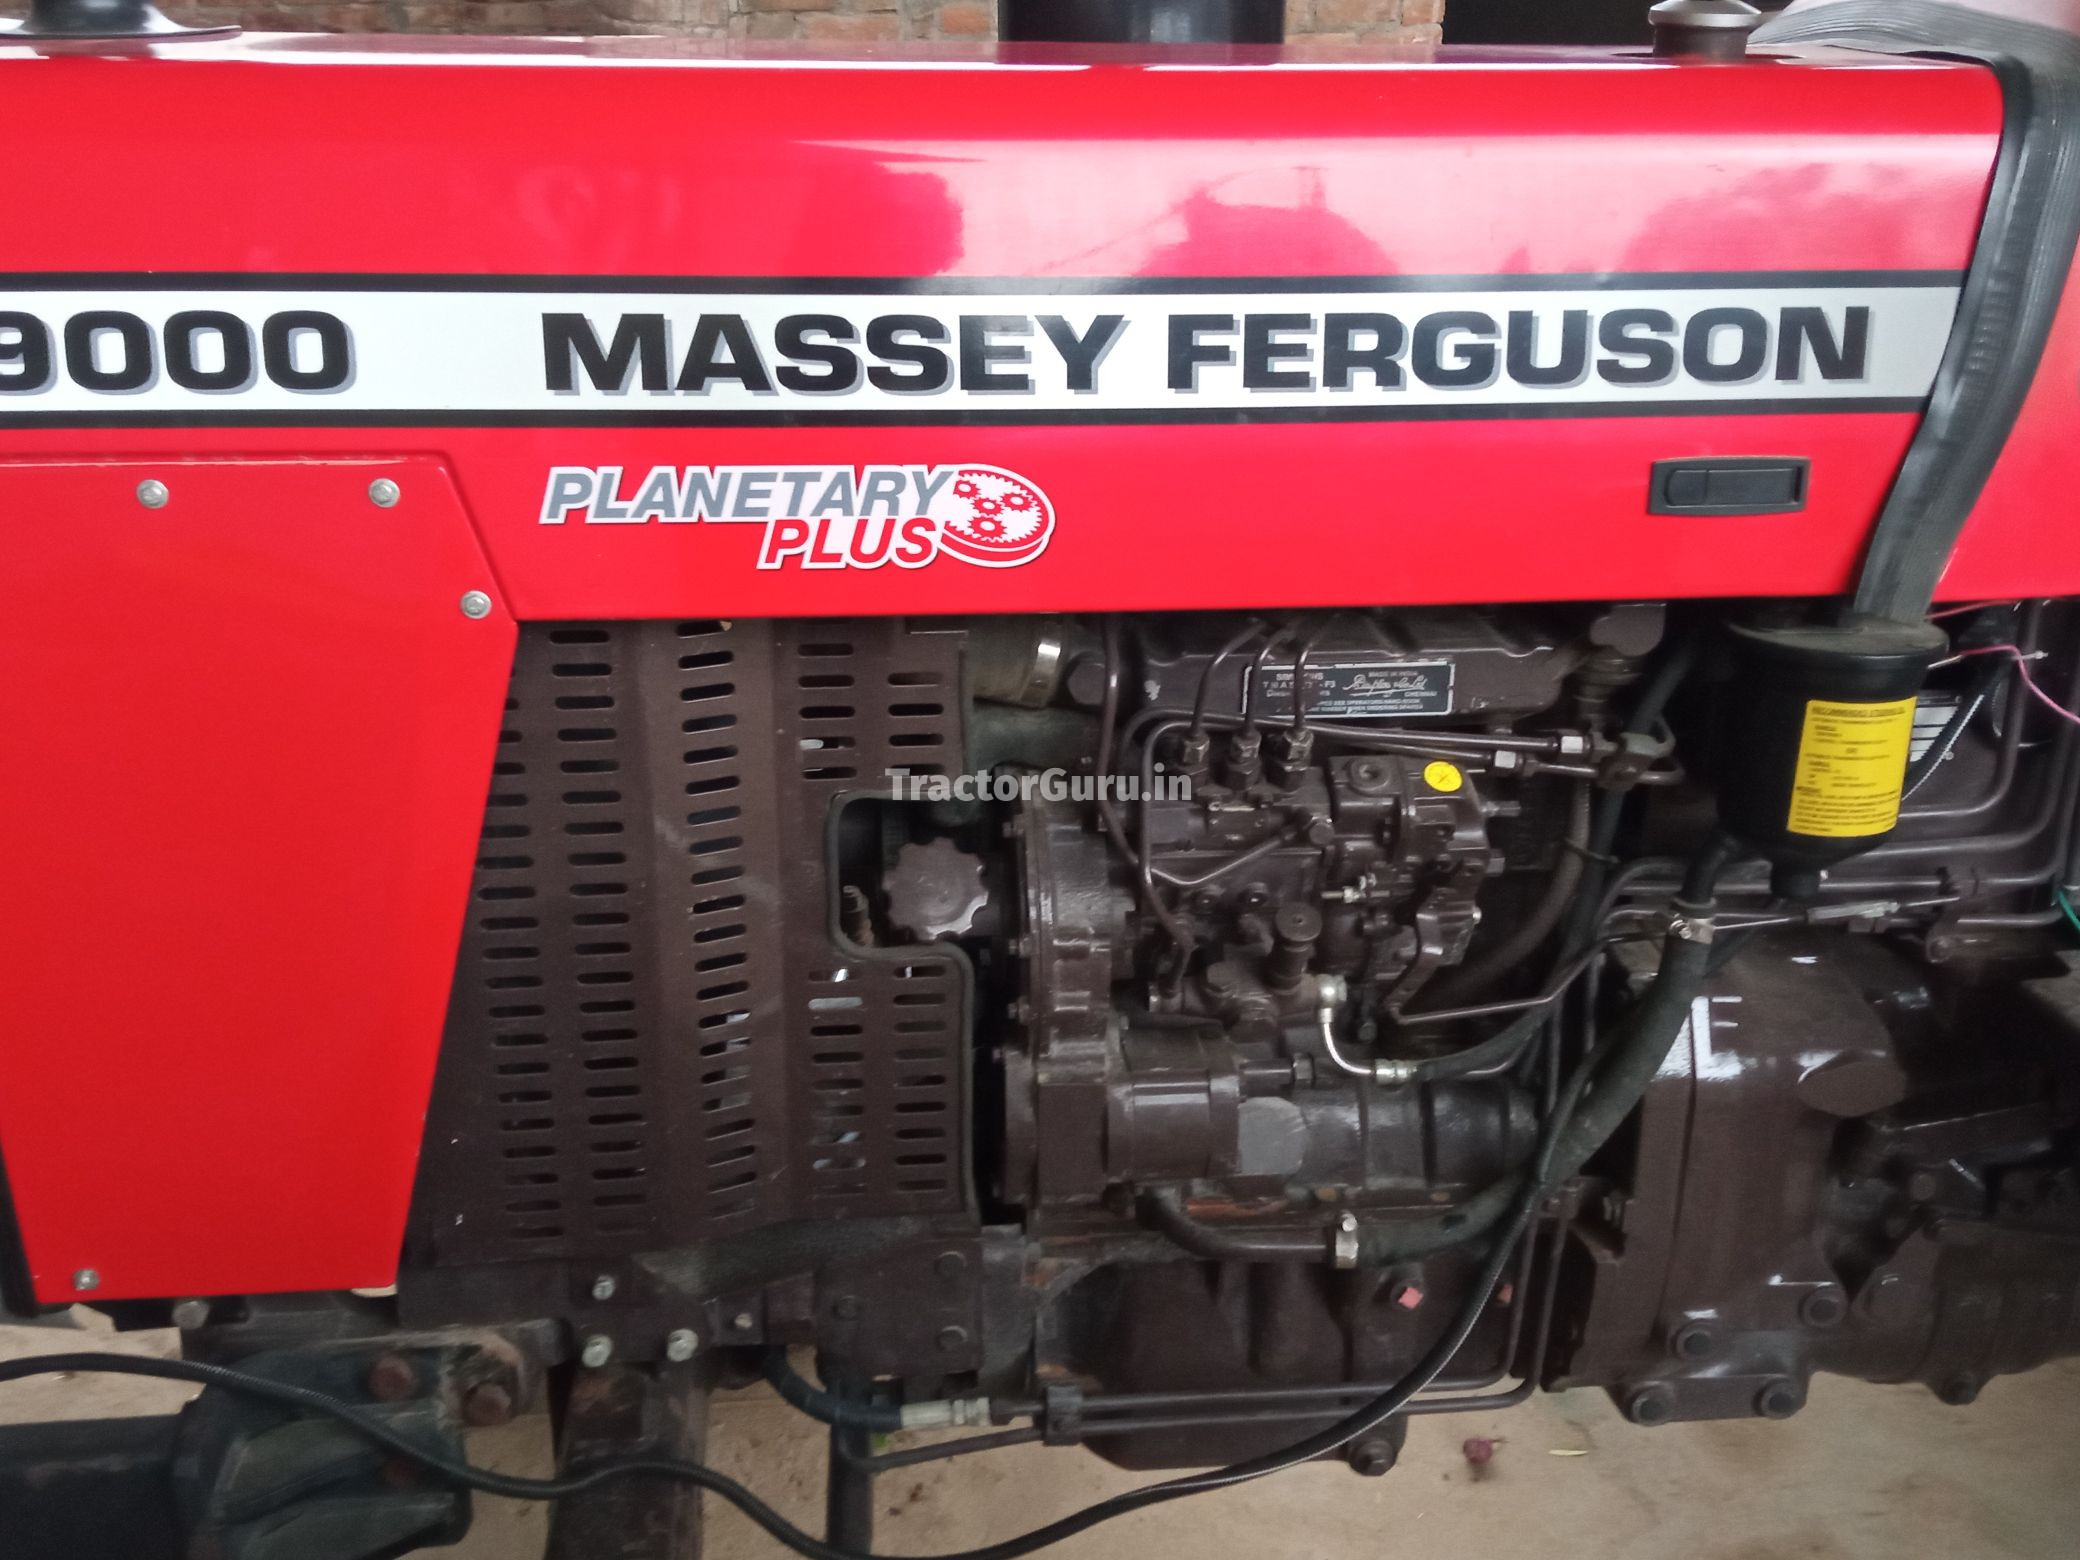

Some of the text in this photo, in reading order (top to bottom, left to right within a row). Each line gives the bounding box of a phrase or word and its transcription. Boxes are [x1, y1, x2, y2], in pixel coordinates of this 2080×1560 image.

[0, 306, 1875, 396] 9000 MASSEY FERGUSON
[540, 465, 957, 524] PLANETARY
[757, 516, 938, 570] PLUS
